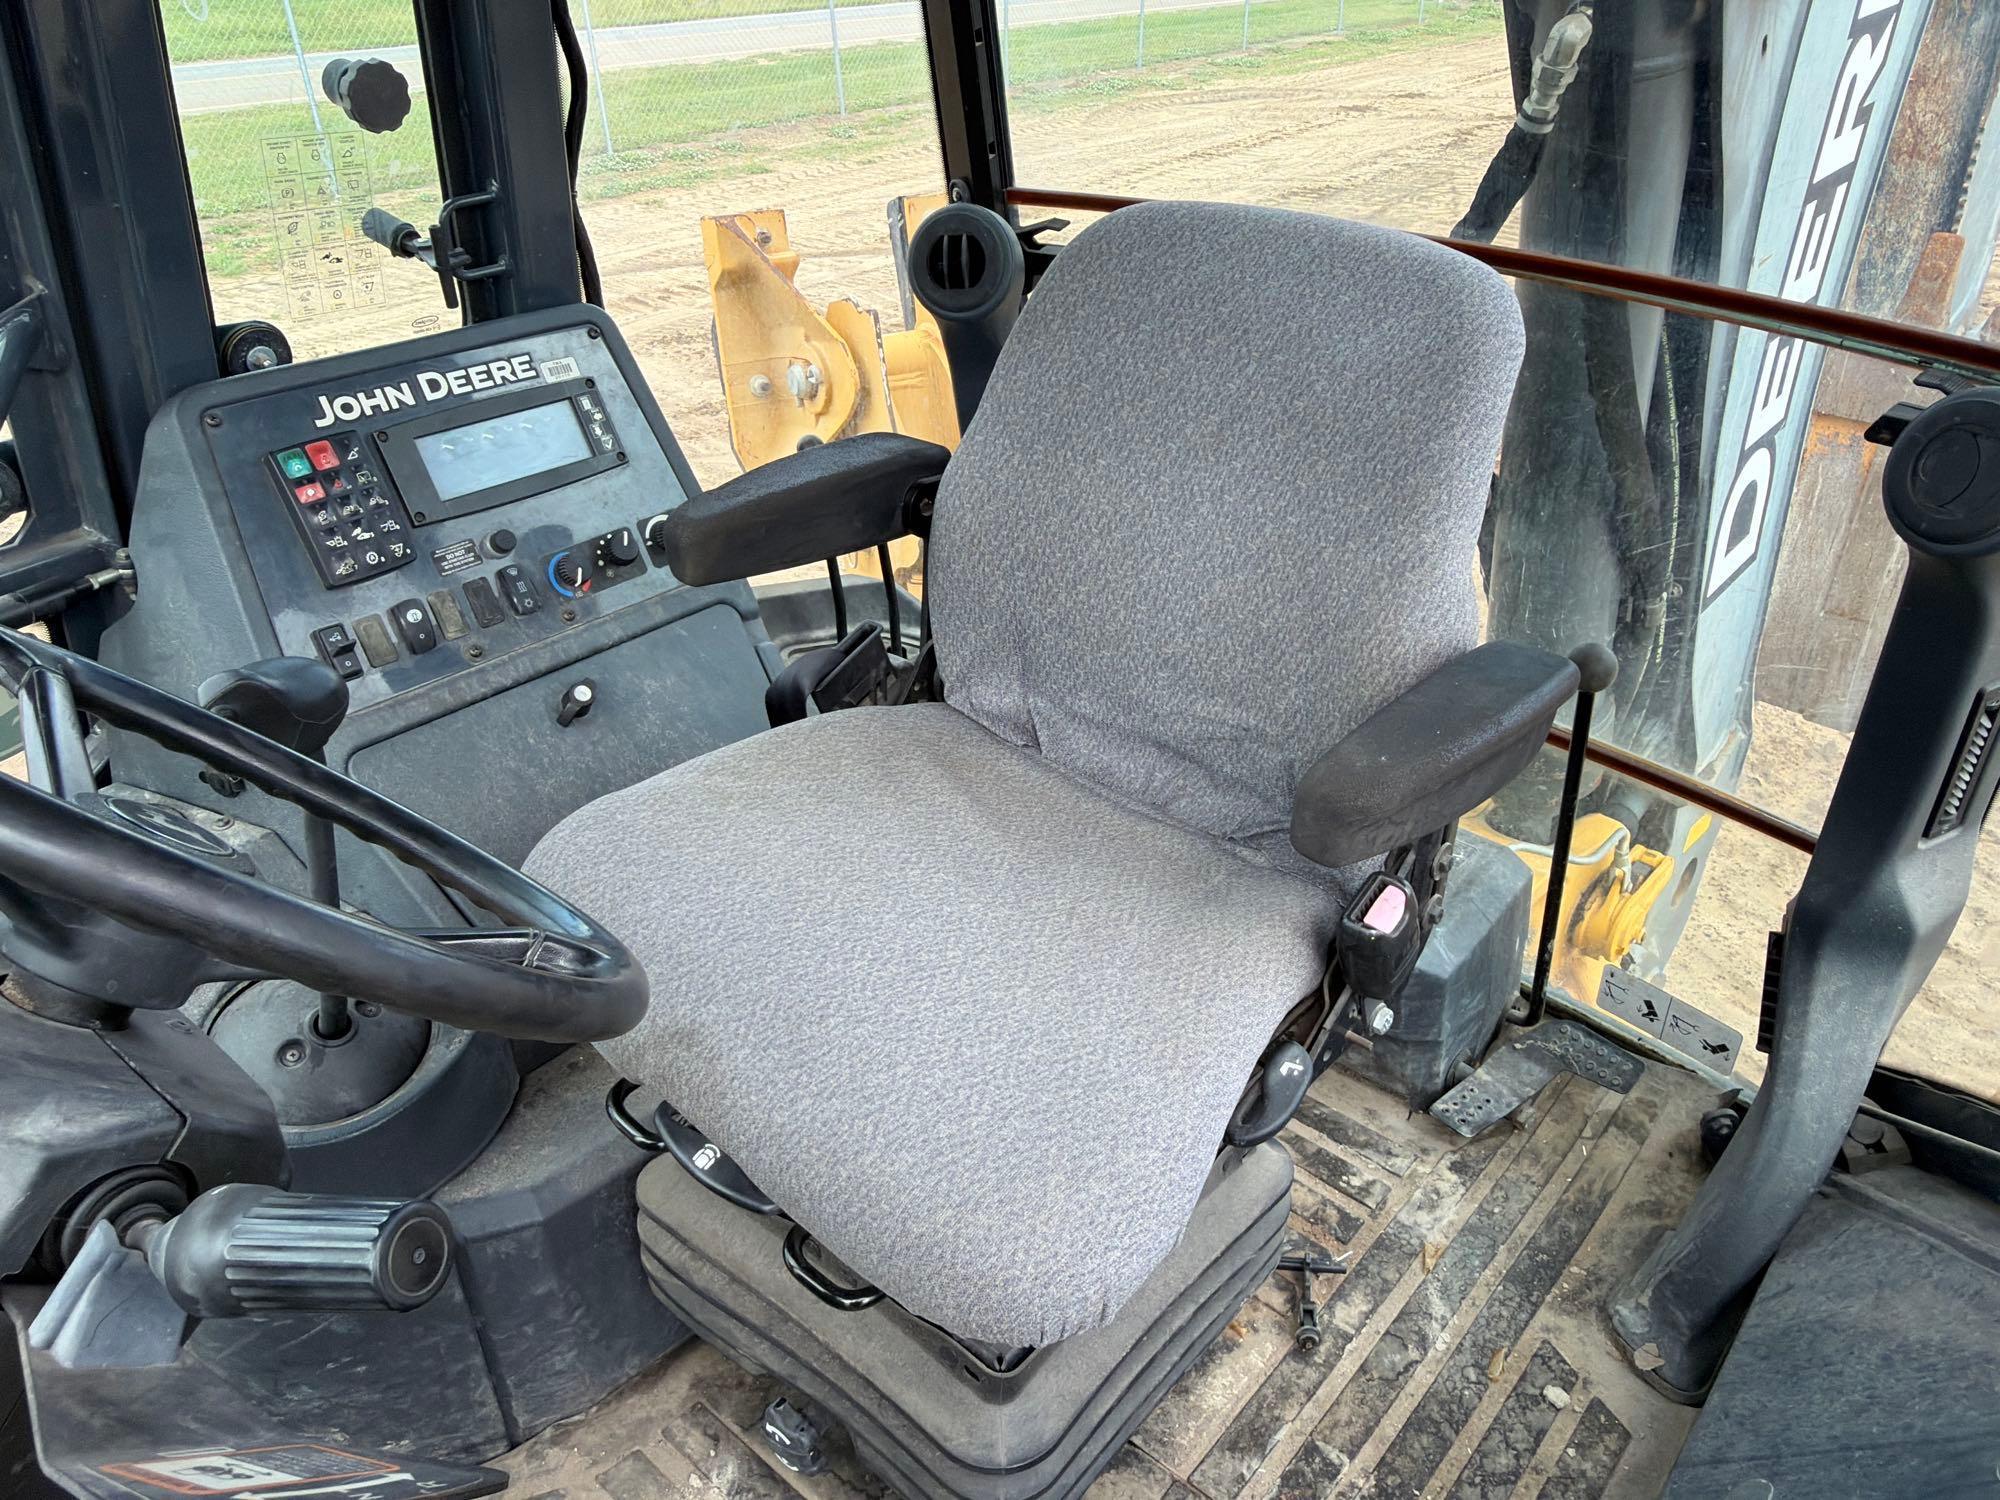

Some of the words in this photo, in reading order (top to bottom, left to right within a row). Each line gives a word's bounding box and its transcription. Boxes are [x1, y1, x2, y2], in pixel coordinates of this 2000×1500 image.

[313, 382, 416, 428] JOHN
[416, 355, 537, 402] DEERE
[1705, 0, 1902, 600] DEER
